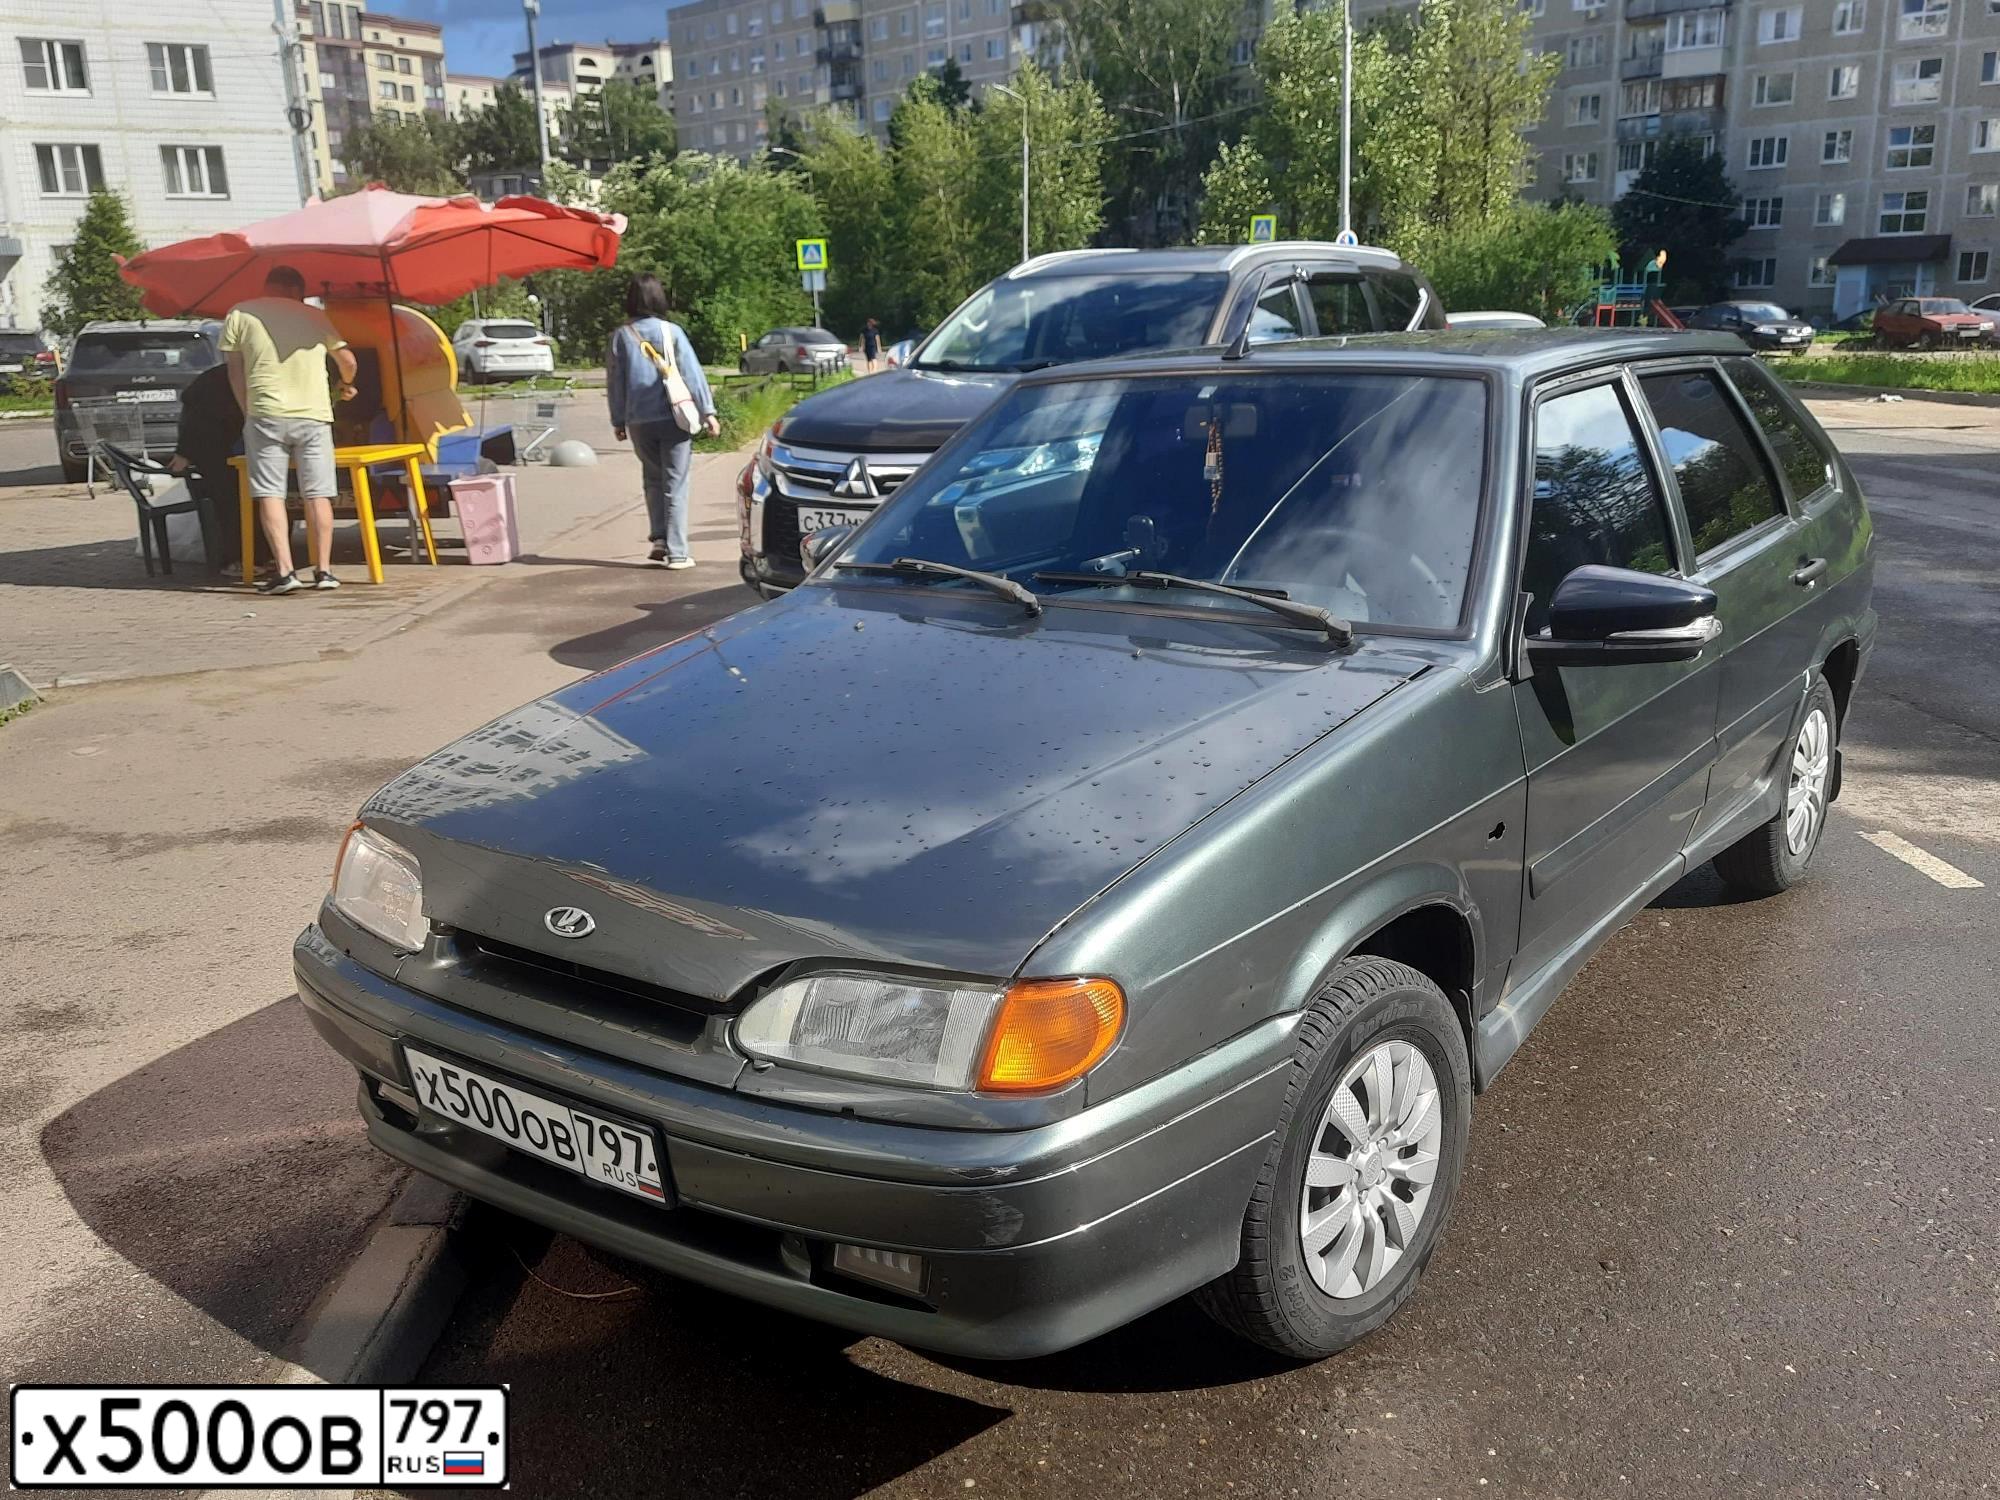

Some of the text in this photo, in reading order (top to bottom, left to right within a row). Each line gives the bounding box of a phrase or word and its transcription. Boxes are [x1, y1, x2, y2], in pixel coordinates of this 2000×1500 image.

[803, 511, 864, 531] С337М
[418, 1067, 642, 1174] Х500ОВ 797
[602, 1163, 637, 1187] RUS
